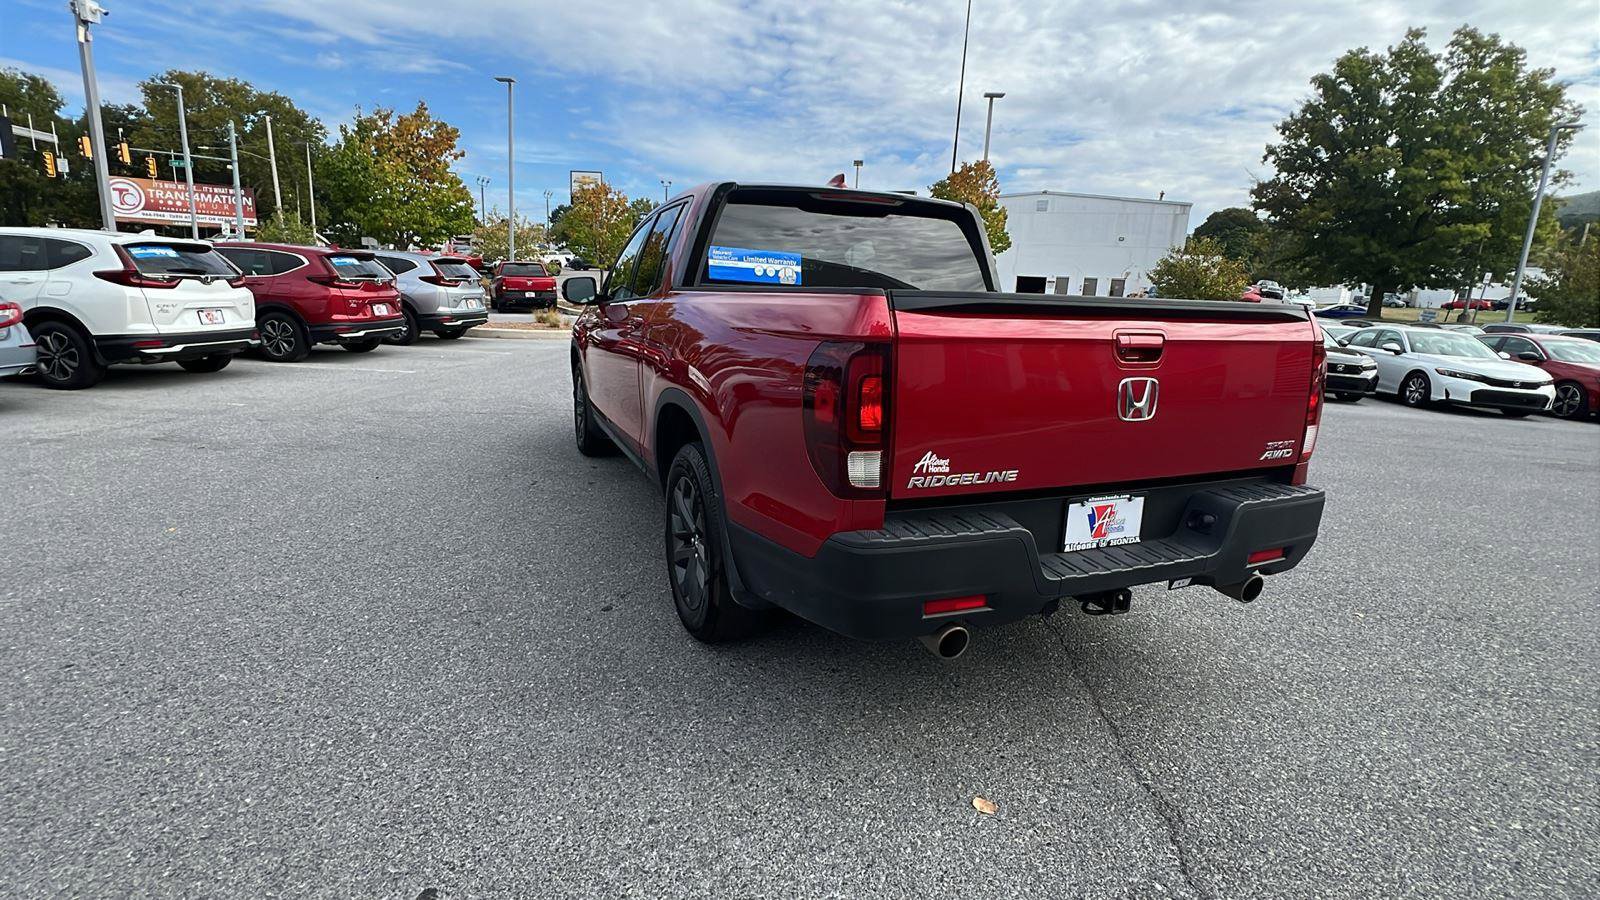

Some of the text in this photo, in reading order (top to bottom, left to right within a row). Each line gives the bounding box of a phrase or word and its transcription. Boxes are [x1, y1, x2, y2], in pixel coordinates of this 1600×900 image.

[743, 255, 767, 264] Limited
[768, 257, 797, 266] Warranty
[1259, 448, 1293, 460] AWD
[928, 465, 950, 473] Honda
[907, 470, 1019, 489] RIDGELINE
[1063, 536, 1141, 552] Altoona HONDA
